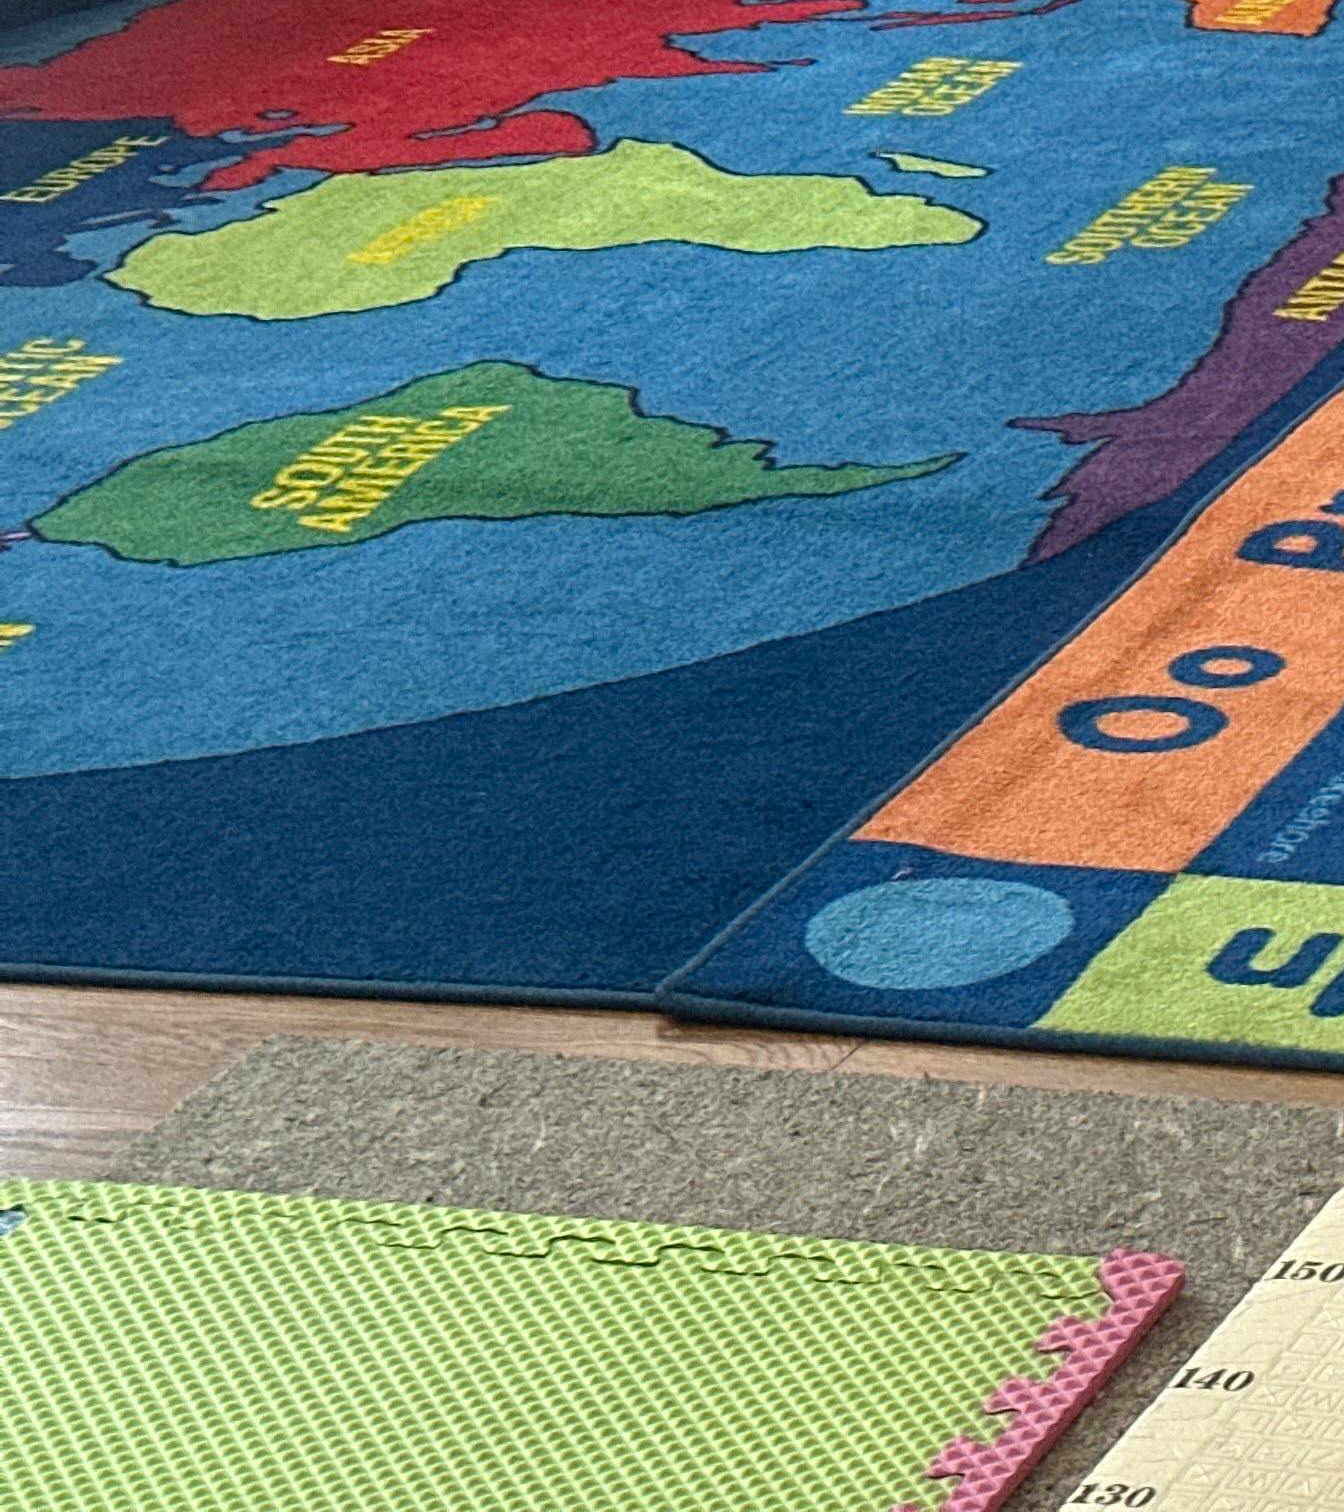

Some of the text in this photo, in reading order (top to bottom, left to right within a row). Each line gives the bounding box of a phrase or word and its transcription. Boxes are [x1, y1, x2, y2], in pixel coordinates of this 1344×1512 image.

[326, 28, 437, 65] ASIA
[842, 56, 972, 115] INDIAN
[901, 60, 1025, 116] OCEAN
[0, 136, 171, 203] EUROPE
[1046, 166, 1218, 265] SOUTHERN
[1131, 183, 1255, 250] OCEAN
[249, 415, 414, 510] SOUTH
[300, 403, 513, 533] AMERICA
[1056, 645, 1286, 754] Oo
[1168, 1368, 1255, 1392] 140
[1069, 1483, 1156, 1509] 130
